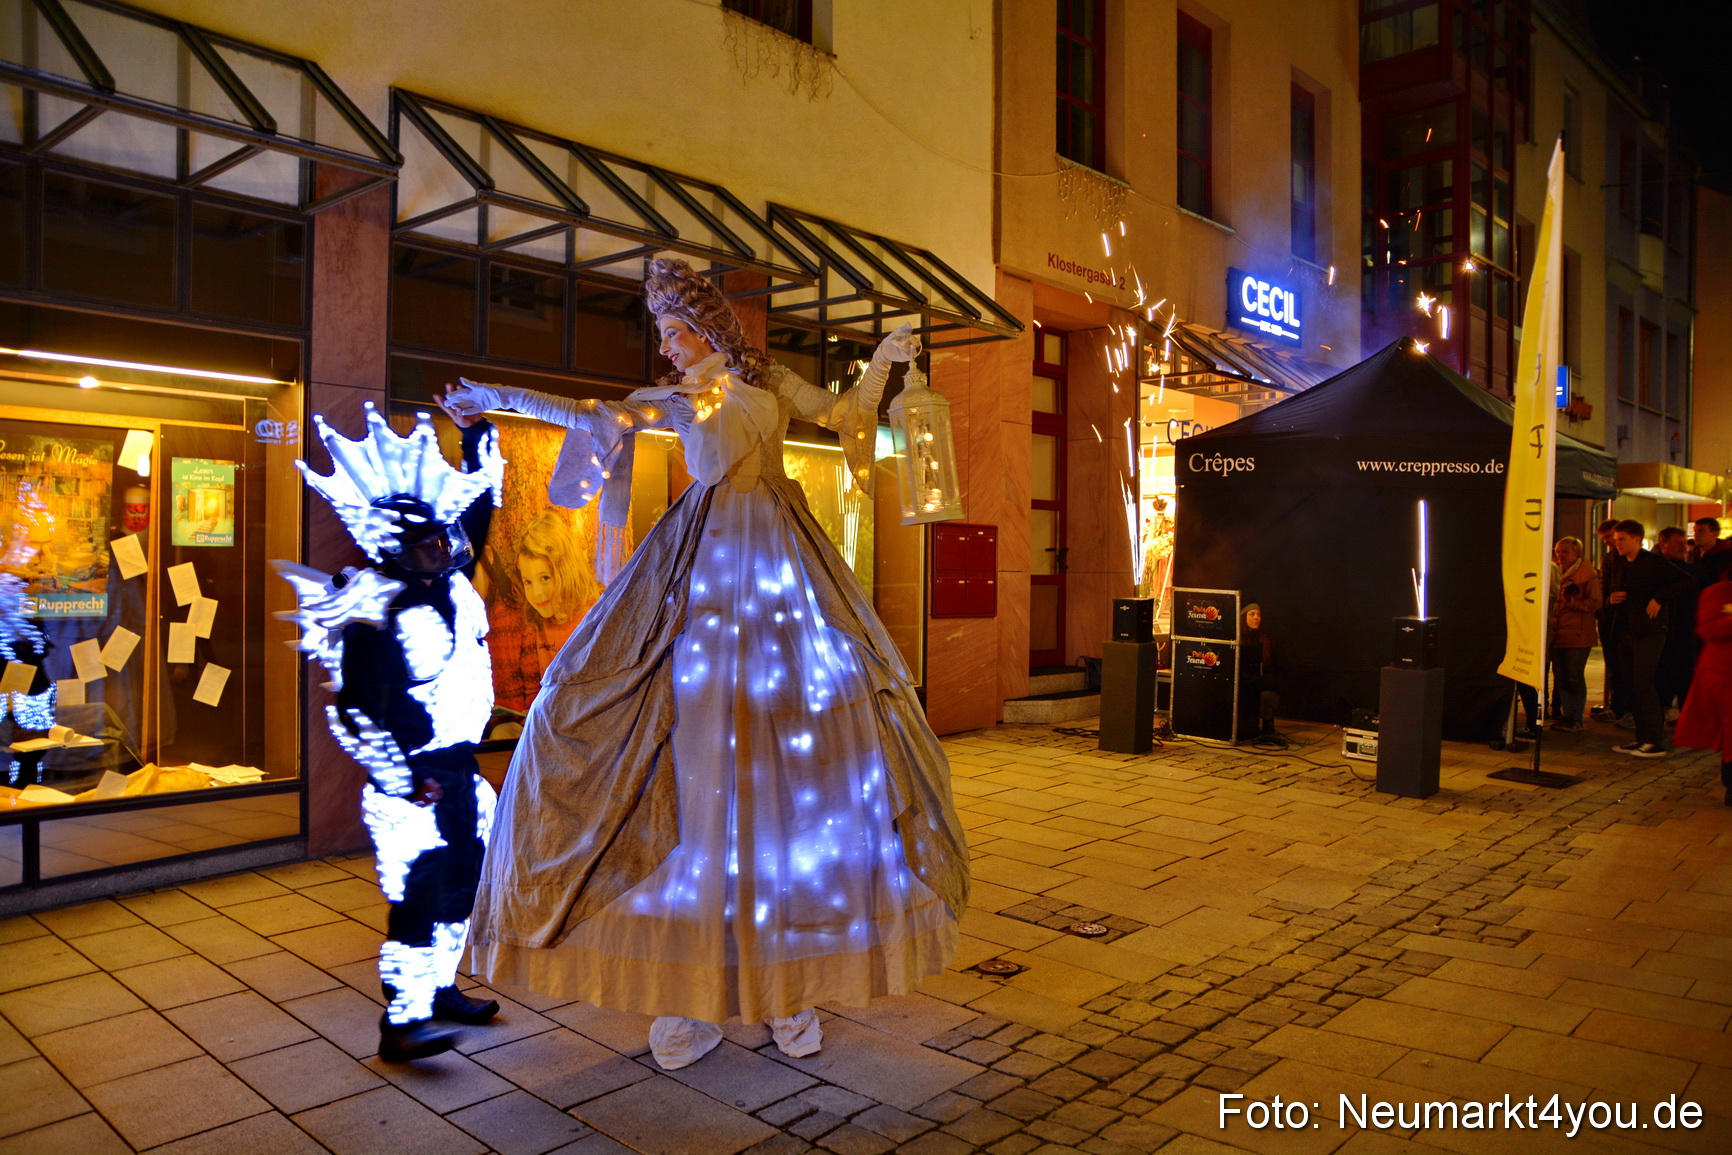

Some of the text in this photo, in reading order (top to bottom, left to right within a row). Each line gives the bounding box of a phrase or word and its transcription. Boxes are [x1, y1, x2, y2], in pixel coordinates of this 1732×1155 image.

[1119, 276, 1126, 291] 2
[1242, 276, 1301, 328] CECIL
[1167, 418, 1214, 446] CEC
[31, 451, 46, 462] ist
[51, 443, 98, 468] Magie
[193, 465, 214, 474] Lesen
[1188, 452, 1255, 477] Crêpes
[1356, 459, 1505, 477] www.creppresso.de
[211, 475, 225, 483] Kopf
[38, 596, 105, 613] Rupprecht
[1187, 608, 1222, 621] Feuershw
[1186, 654, 1221, 667] Feuershw
